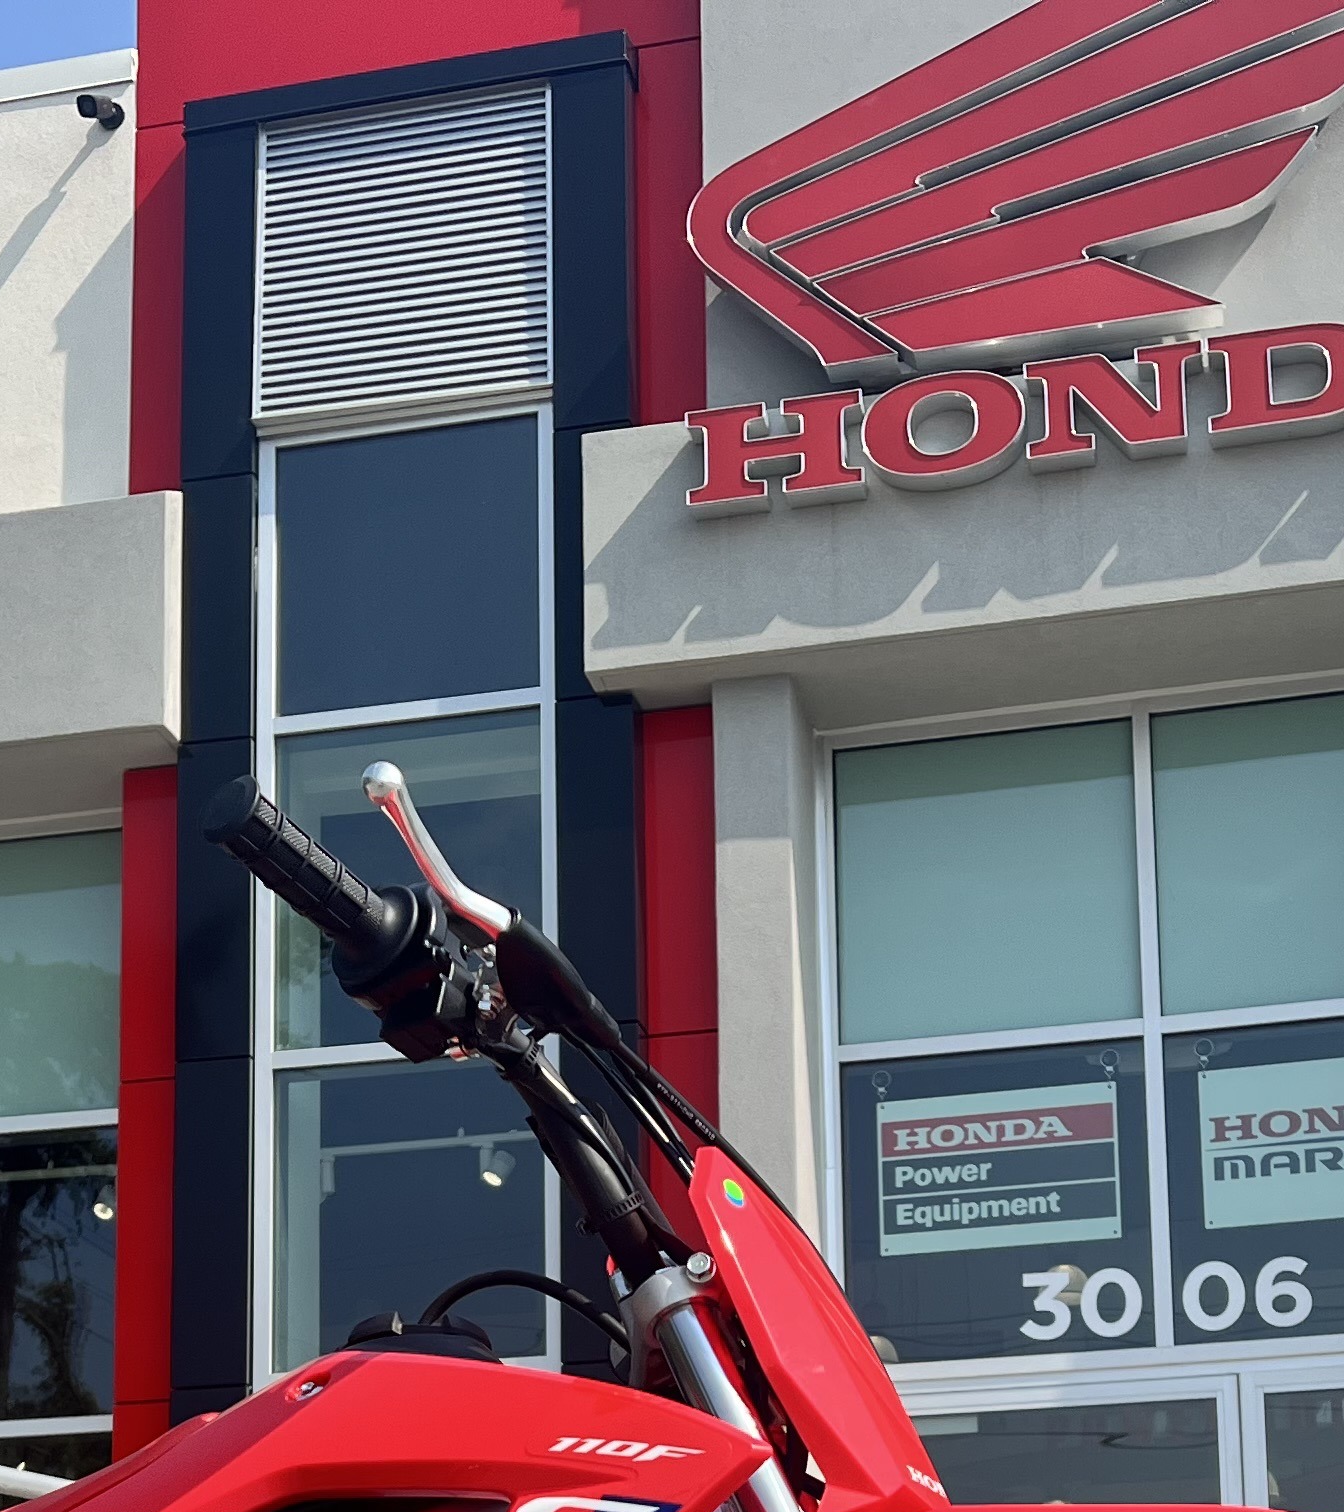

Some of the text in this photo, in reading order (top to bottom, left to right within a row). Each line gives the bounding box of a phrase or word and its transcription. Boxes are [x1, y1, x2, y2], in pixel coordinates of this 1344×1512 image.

[892, 1115, 1073, 1152] HONDA
[894, 1161, 991, 1188] Power
[895, 1191, 1061, 1227] Equipment
[548, 1436, 707, 1462] 110F
